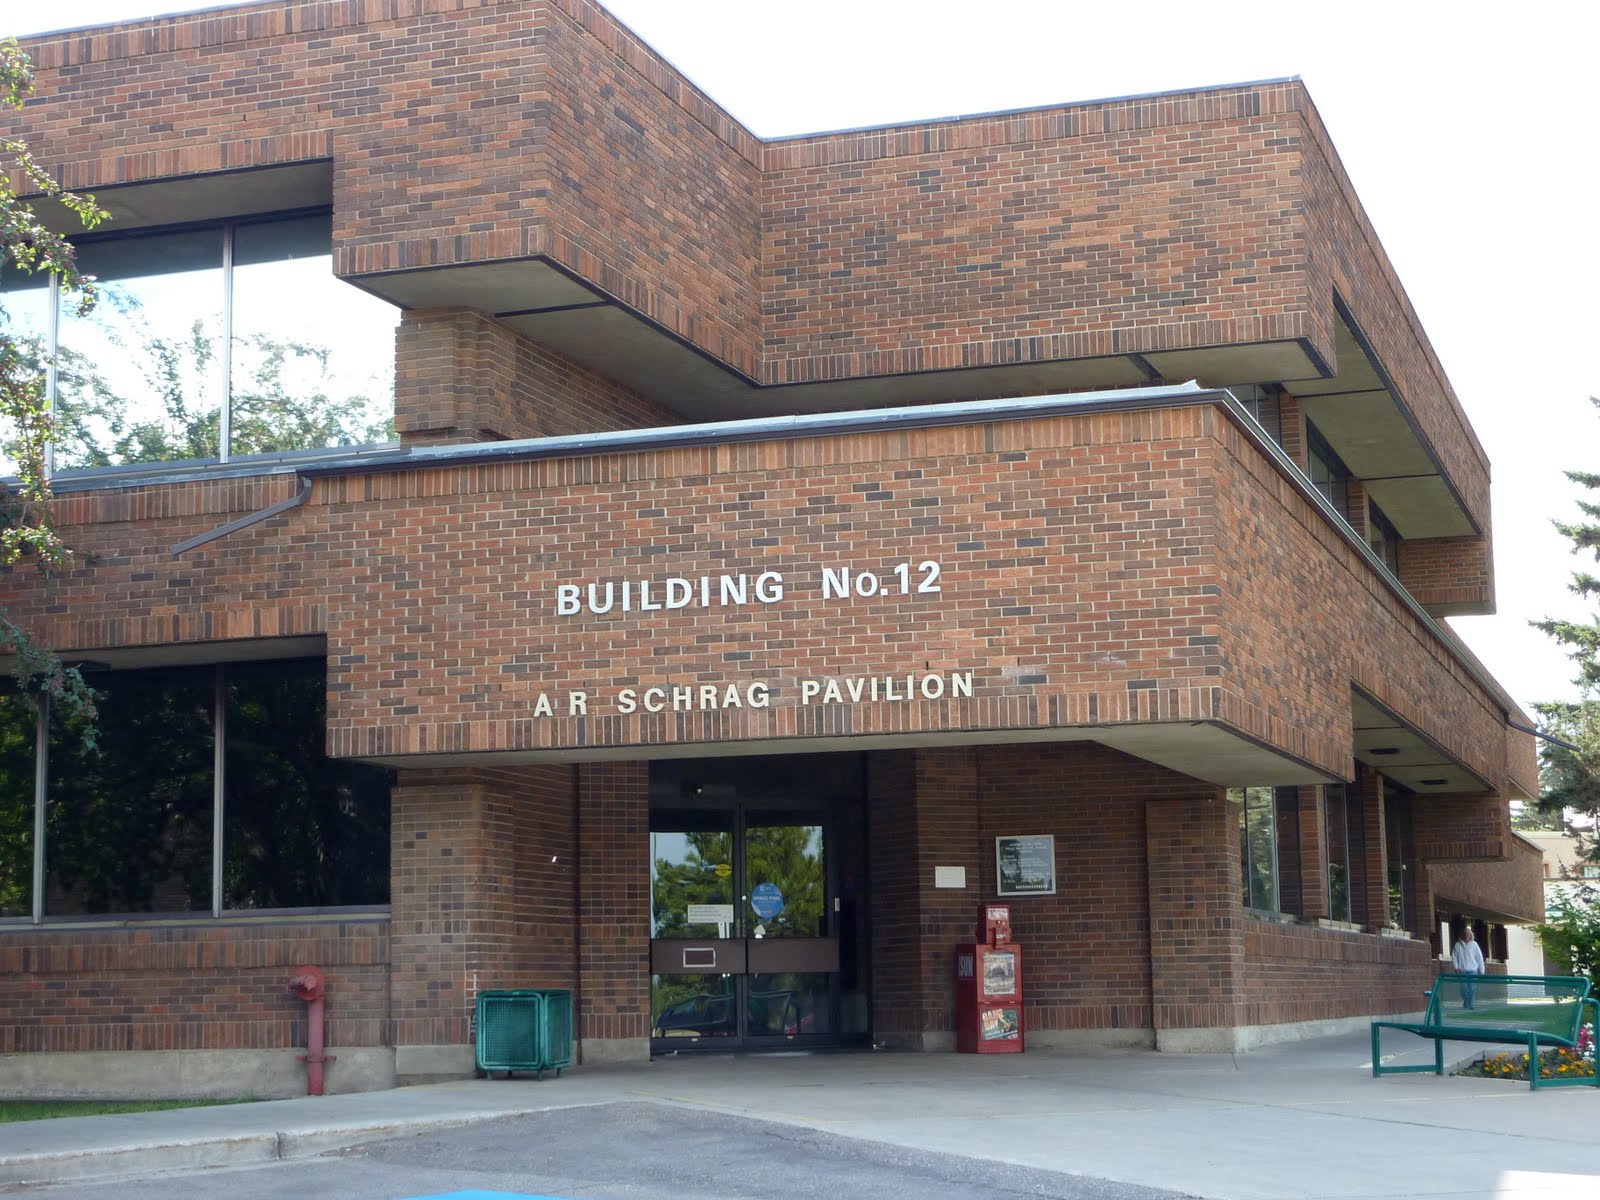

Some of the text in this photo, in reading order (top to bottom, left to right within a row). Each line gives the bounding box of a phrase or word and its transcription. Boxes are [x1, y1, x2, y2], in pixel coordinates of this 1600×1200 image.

[556, 560, 943, 616] BUILDING No.12
[617, 681, 770, 714] SCHRAG
[802, 672, 973, 706] PAVILION
[959, 955, 974, 977] SUN
